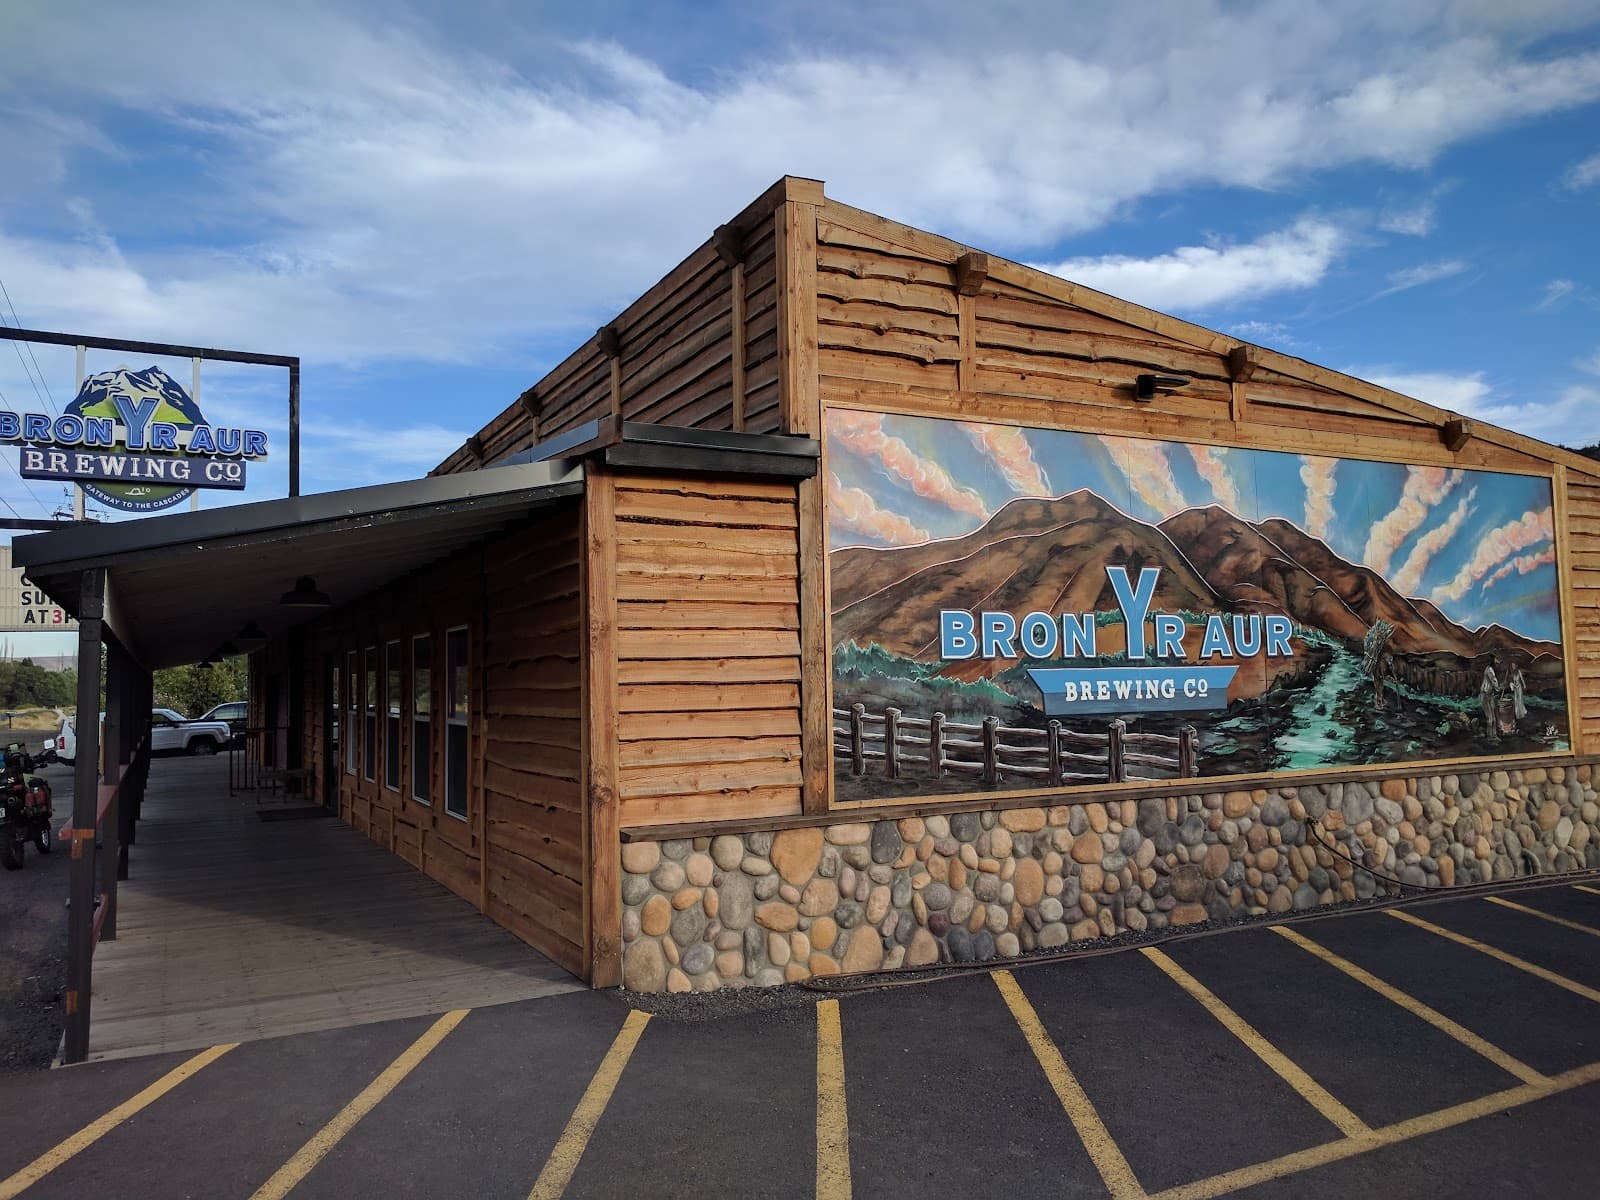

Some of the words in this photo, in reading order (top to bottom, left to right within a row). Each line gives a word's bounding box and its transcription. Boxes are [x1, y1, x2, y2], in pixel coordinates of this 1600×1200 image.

[0, 411, 112, 445] BRON
[188, 426, 268, 456] AUR
[25, 451, 190, 479] BREWING
[86, 484, 119, 504] GATEWAY
[153, 488, 190, 507] CASCADES
[22, 591, 53, 605] SU
[24, 609, 48, 623] AT
[940, 610, 1096, 660] BRON
[1200, 615, 1294, 658] AUR
[1065, 679, 1175, 701] BREWING
